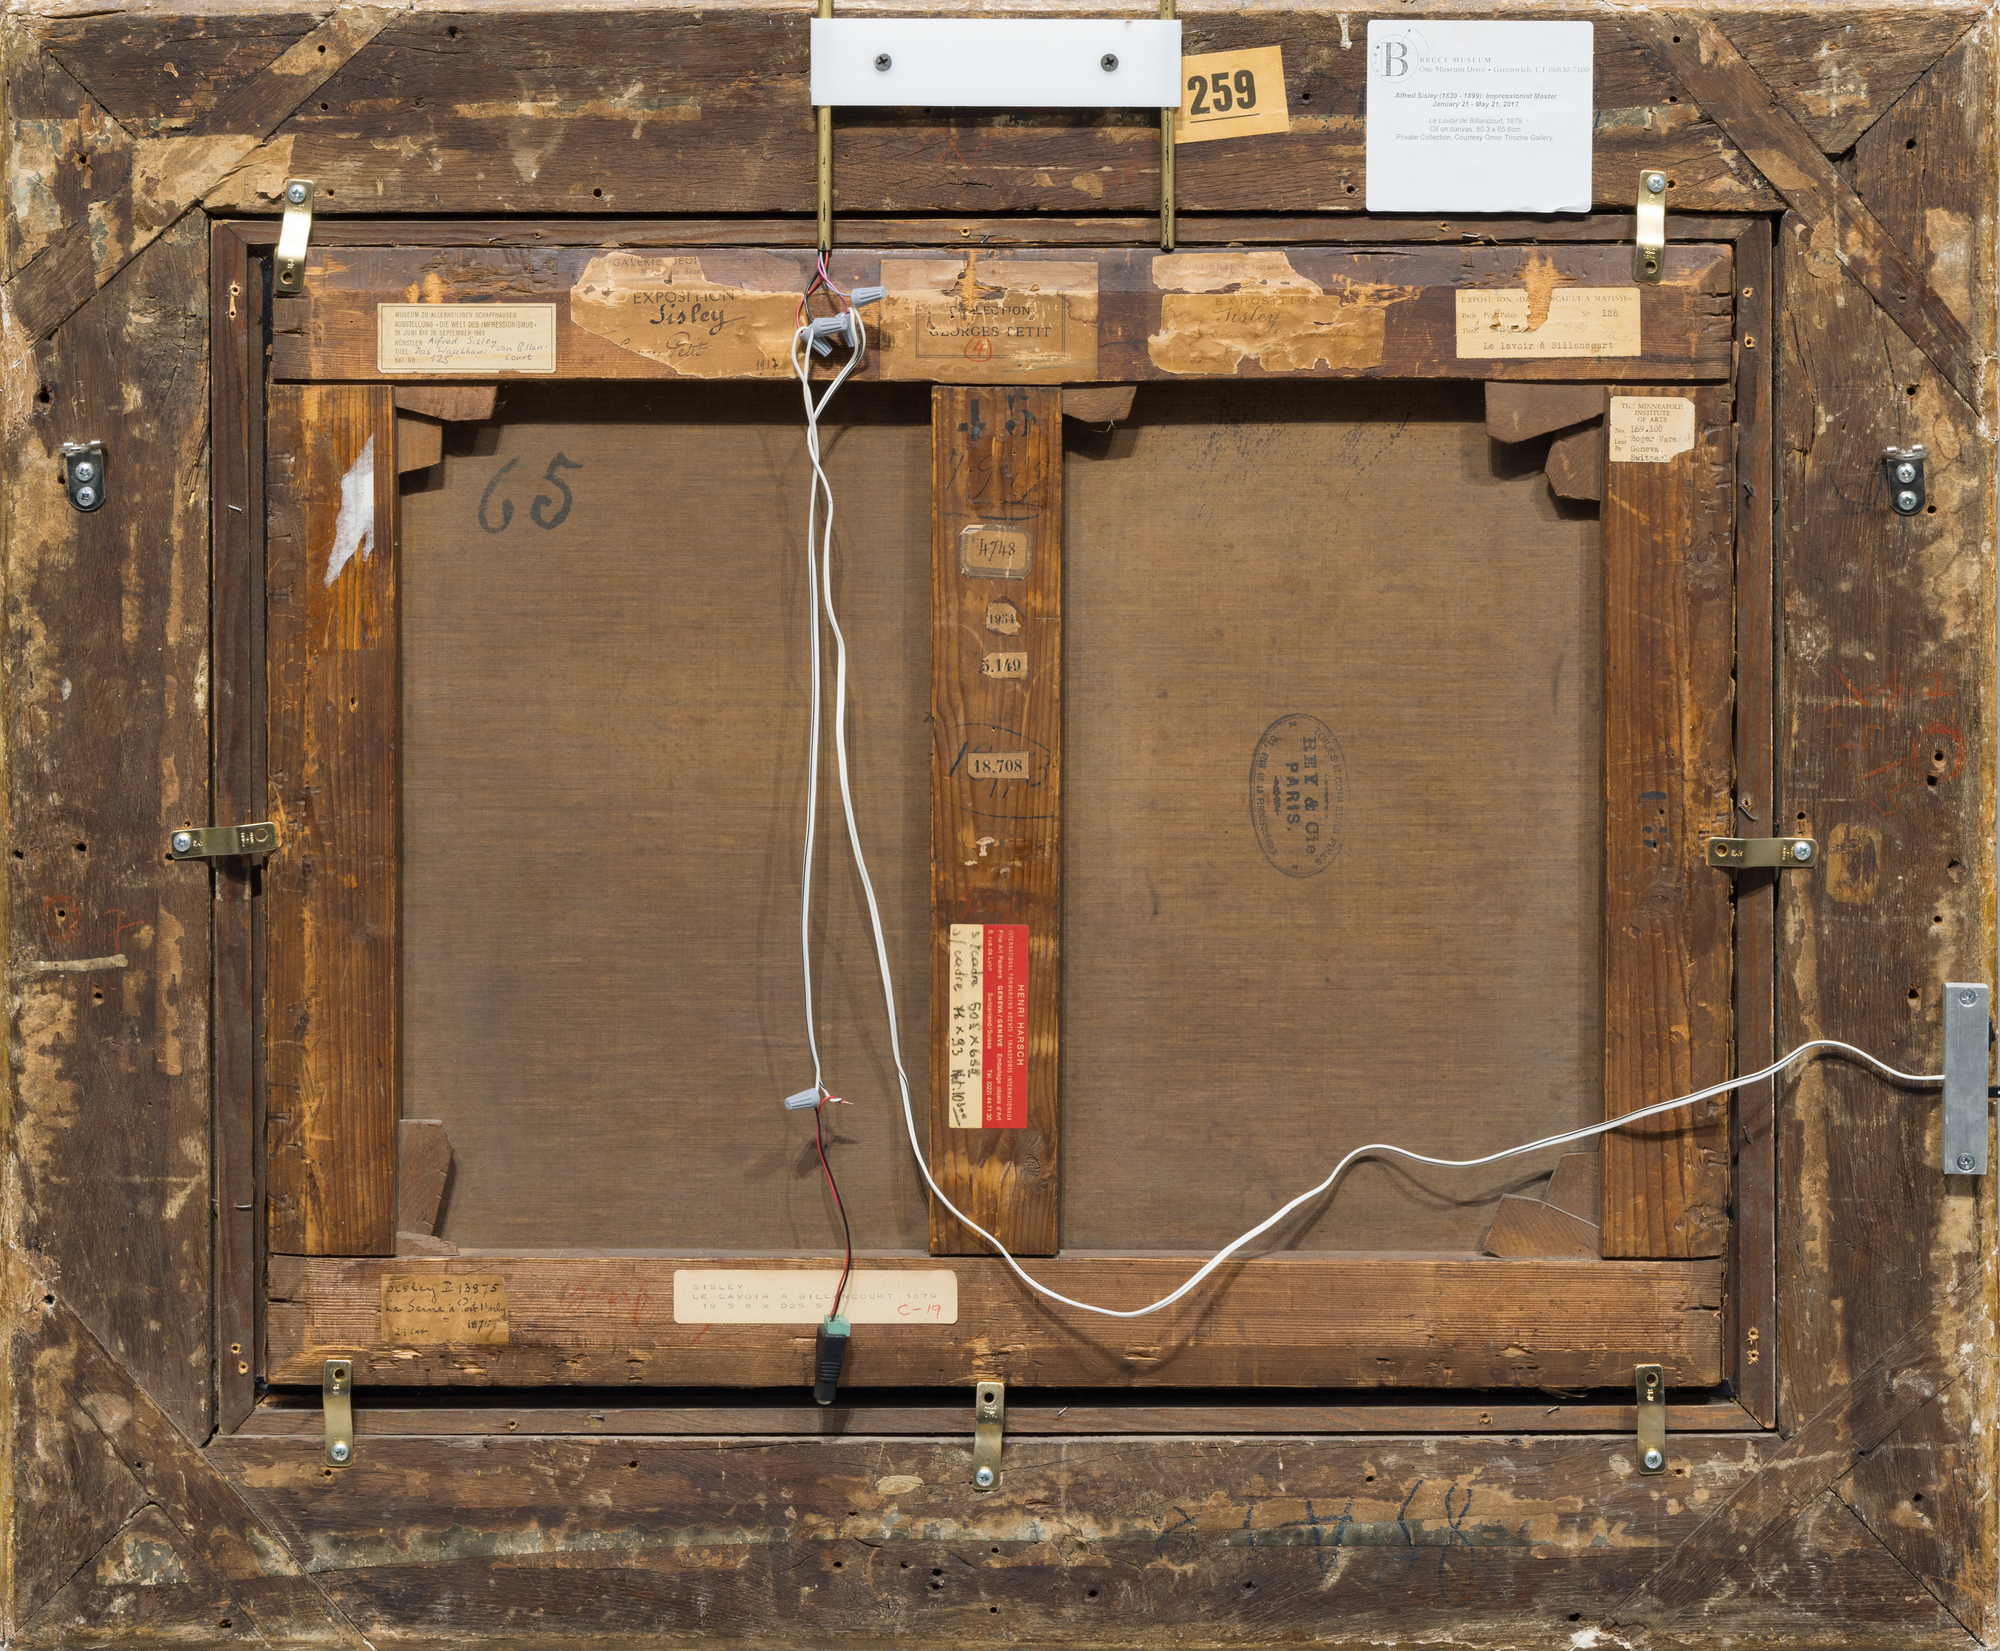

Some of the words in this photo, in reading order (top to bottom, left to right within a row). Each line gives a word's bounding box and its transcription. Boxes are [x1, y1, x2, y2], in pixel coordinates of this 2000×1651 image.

[1493, 66, 1534, 74] Greenwich,
[1187, 69, 1257, 116] 259
[1394, 92, 1416, 100] Alfred
[1417, 92, 1438, 100] Sisley
[1439, 92, 1459, 100] (1839
[1486, 92, 1533, 100] Impressionist
[1432, 101, 1460, 109] January
[1475, 101, 1490, 109] May
[1491, 101, 1501, 109] 21,
[1469, 117, 1505, 125] Billancourt,
[1420, 134, 1453, 142] Collection,
[1454, 134, 1483, 143] Courtesy
[1504, 134, 1529, 142] Tiroche
[613, 257, 662, 267] GALERIE
[1215, 296, 1319, 306] EXPOSITION
[650, 302, 746, 336] Sisley
[1500, 311, 1518, 319] Palais
[1602, 309, 1619, 318] 126
[394, 338, 425, 347] KÜNSTLER:
[427, 337, 458, 348] Alfred
[466, 336, 497, 348] Sisley
[1483, 341, 1494, 350] Le
[1500, 341, 1534, 350] lavoir
[1540, 341, 1546, 350] à
[414, 347, 431, 355] Das
[437, 346, 488, 355] Waschhaus
[429, 354, 453, 365] 125
[1630, 435, 1655, 444] Roger
[478, 451, 584, 534] 65
[978, 537, 1016, 562] 4748
[973, 759, 1023, 774] 18.708
[1303, 736, 1319, 787] REY
[1304, 796, 1319, 811] &
[987, 947, 993, 956] de
[1017, 984, 1025, 1018] HENRI
[1016, 1022, 1025, 1066] HARSCH
[995, 1053, 1003, 1084] Emballage
[986, 1096, 992, 1104] 44
[692, 1283, 744, 1291] SISLEY
[906, 1292, 938, 1300] 1879
[407, 1298, 445, 1313] Seine
